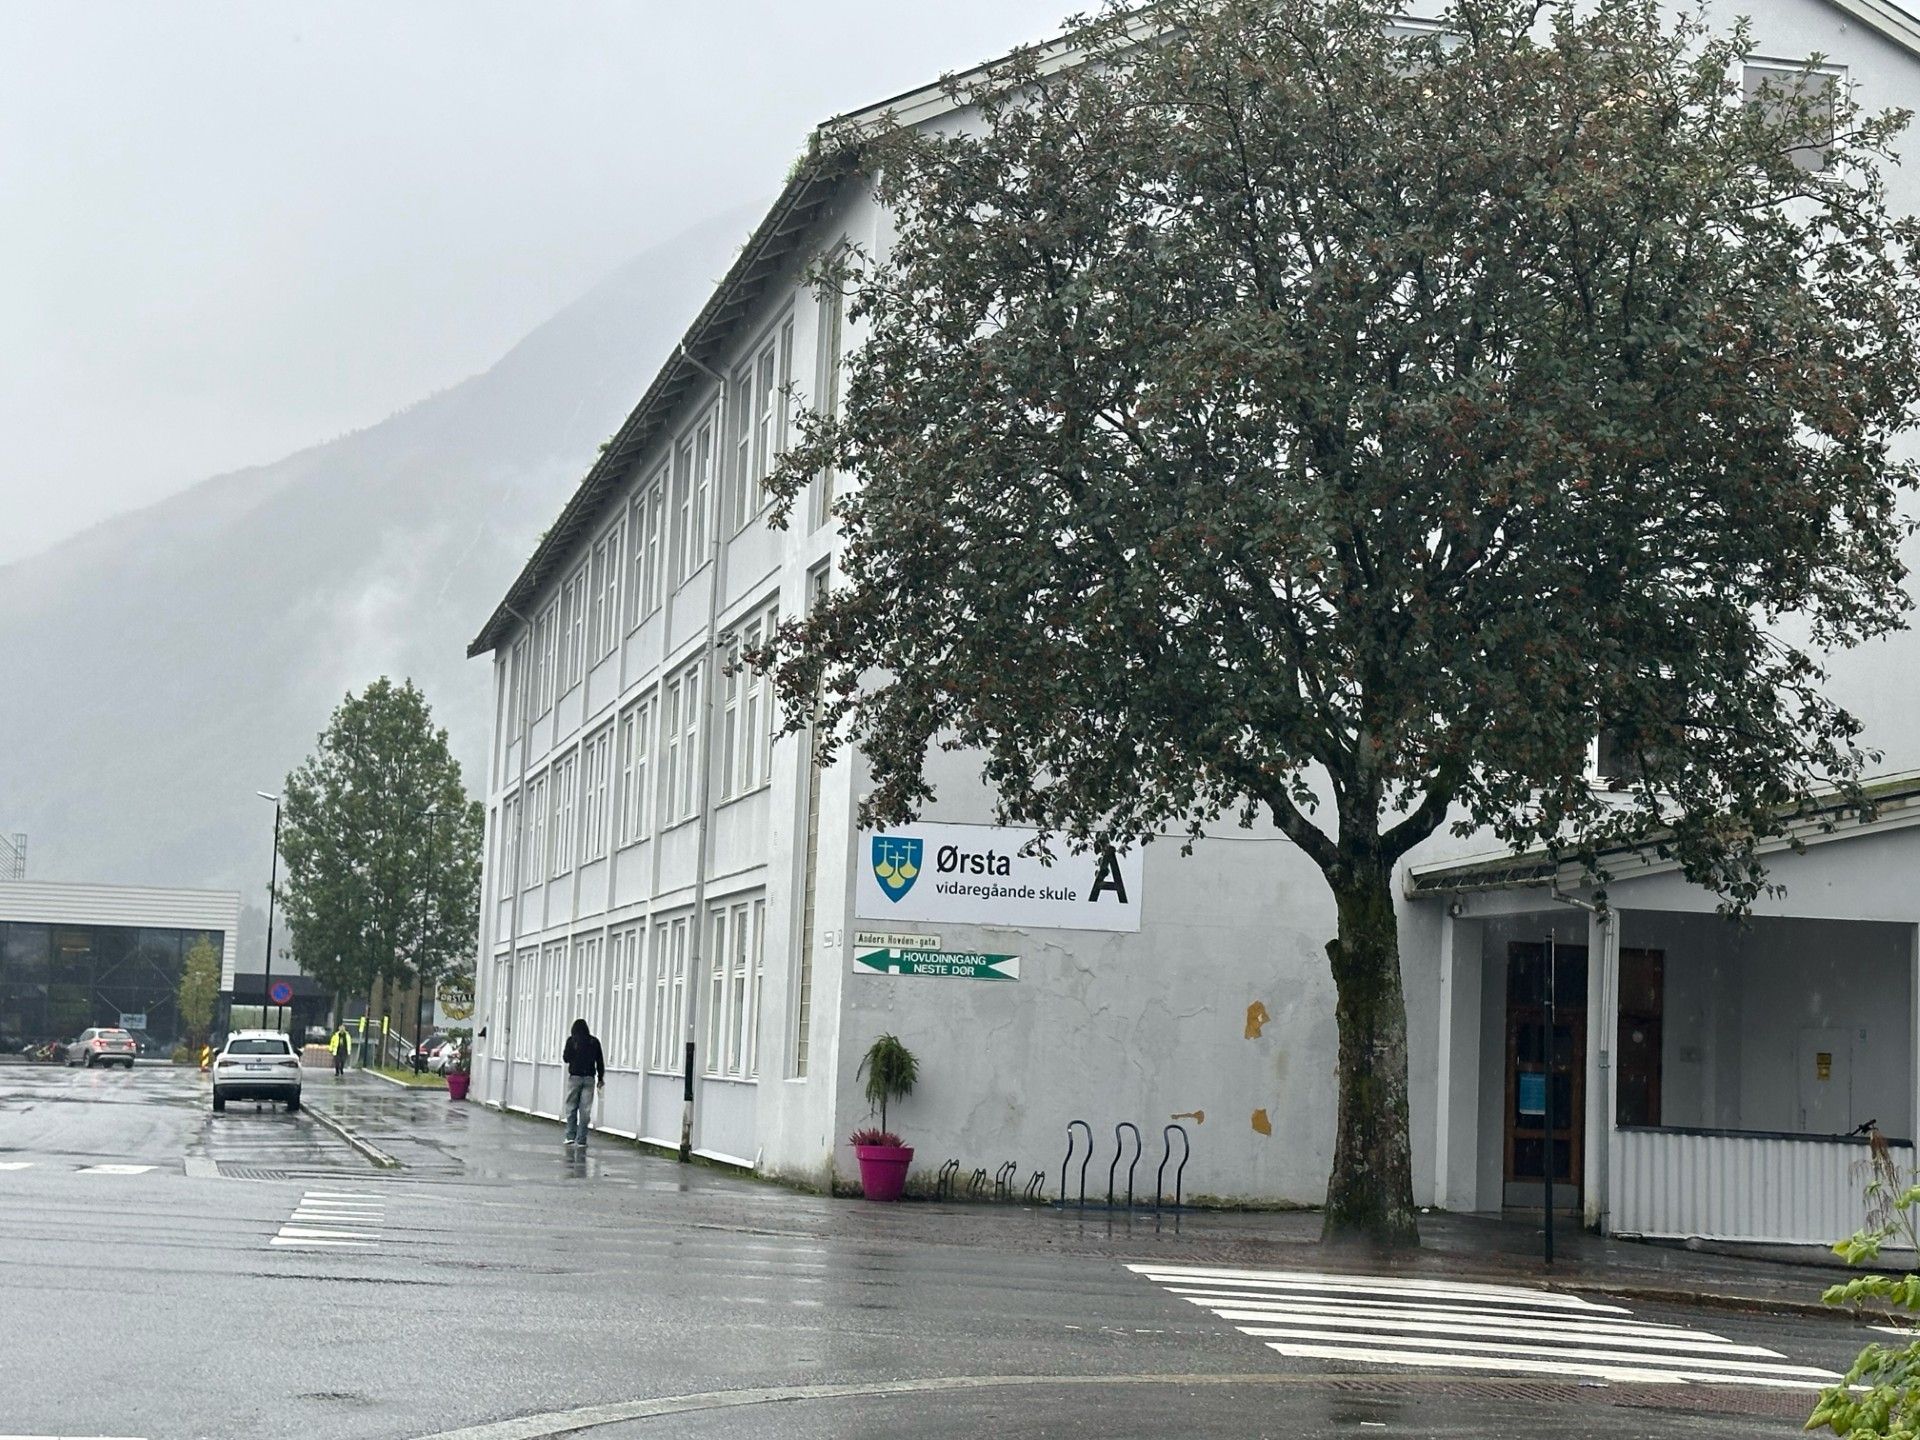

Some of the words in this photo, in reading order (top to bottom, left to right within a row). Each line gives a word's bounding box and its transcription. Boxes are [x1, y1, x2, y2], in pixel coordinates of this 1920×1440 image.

[936, 845, 1010, 876] Ørsta
[1088, 845, 1129, 904] A
[936, 881, 1035, 900] vidaregåande
[1039, 886, 1077, 902] skule
[858, 933, 885, 944] Anders
[903, 952, 986, 965] HOVUDINNGANG
[914, 964, 948, 975] NESTE
[952, 966, 975, 975] DØR
